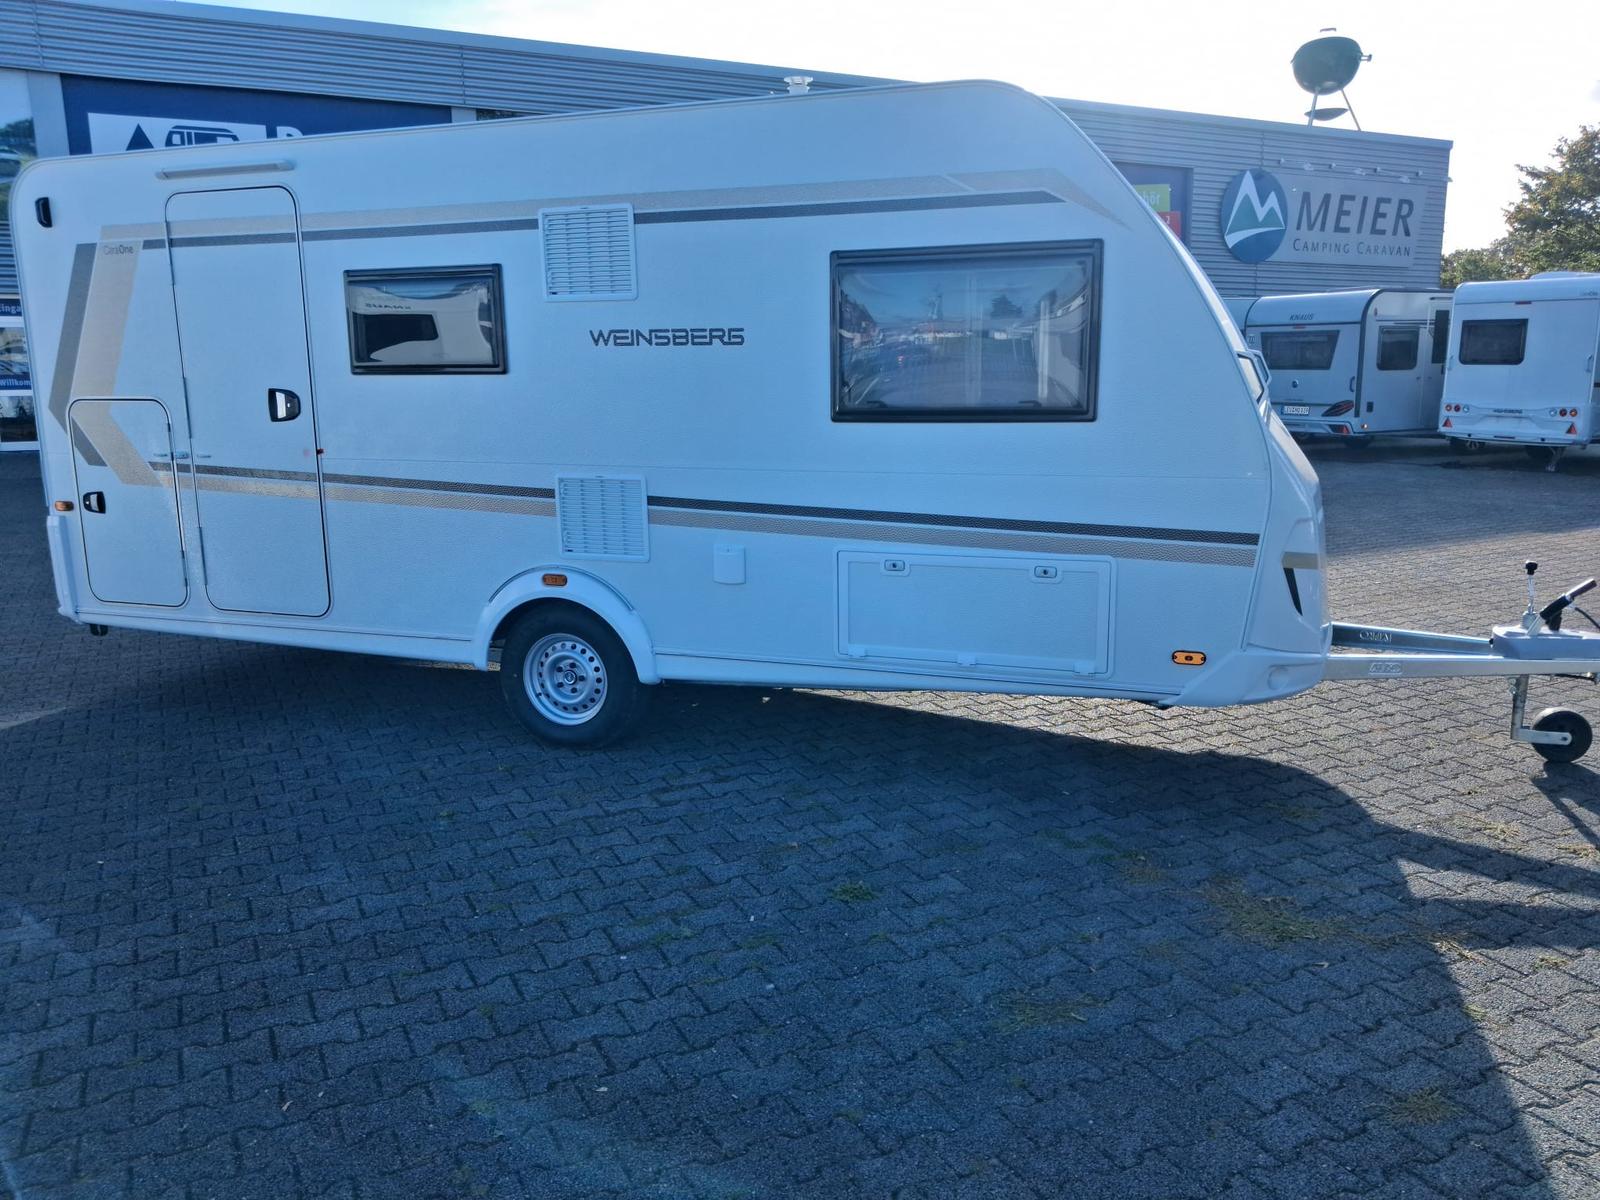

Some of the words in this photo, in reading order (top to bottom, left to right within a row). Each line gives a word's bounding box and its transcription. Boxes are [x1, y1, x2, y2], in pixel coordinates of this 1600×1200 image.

[1296, 191, 1414, 237] MEIER
[1293, 238, 1349, 255] CAMPING
[1356, 242, 1411, 257] CARAVAN
[1289, 313, 1314, 321] KNAUS
[589, 327, 745, 347] WEINSBERG
